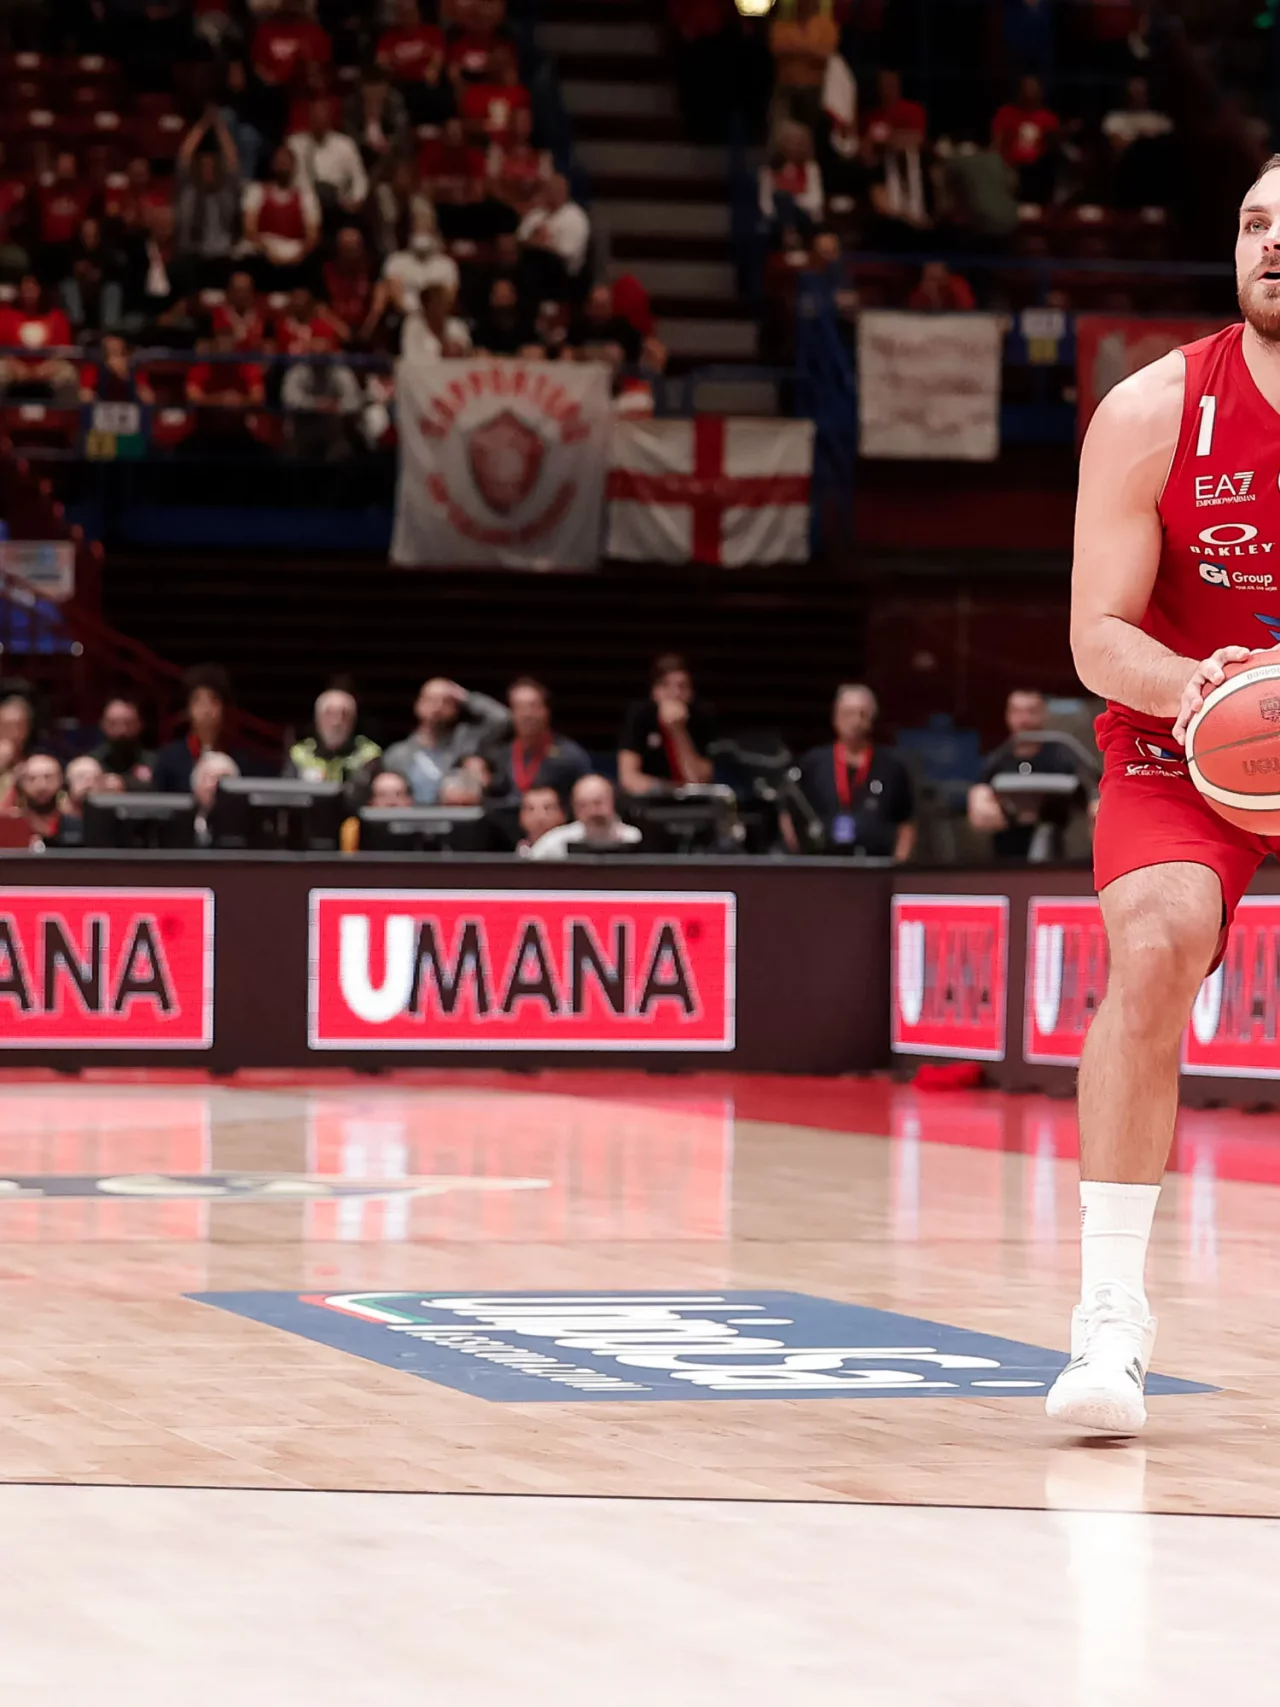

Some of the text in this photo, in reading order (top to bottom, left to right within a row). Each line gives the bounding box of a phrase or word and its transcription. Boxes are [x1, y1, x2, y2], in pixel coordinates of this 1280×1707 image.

[1196, 394, 1216, 457] 1
[1195, 471, 1255, 499] EA7
[1189, 543, 1274, 557] OAKLEY
[1232, 571, 1273, 586] Group
[339, 914, 697, 1023] UMANA
